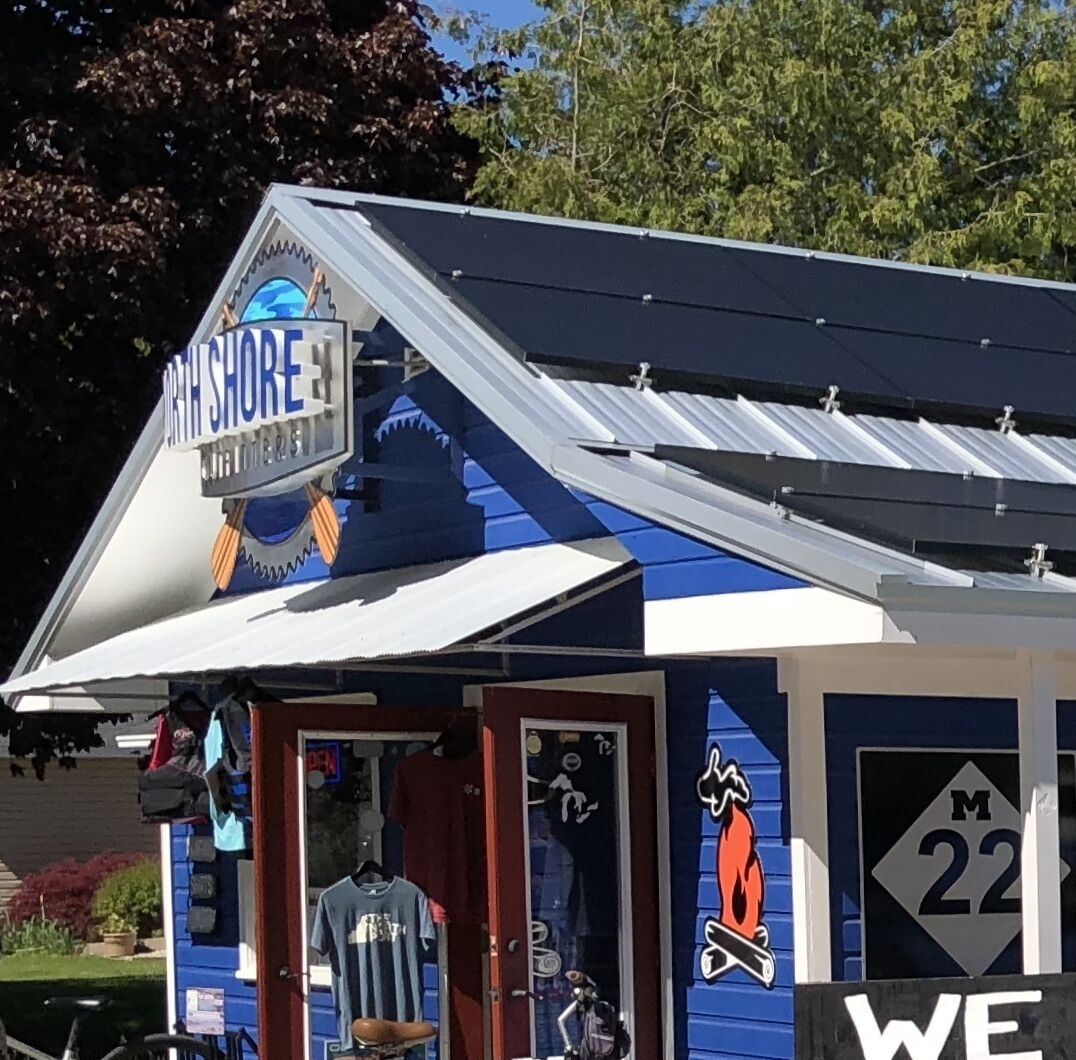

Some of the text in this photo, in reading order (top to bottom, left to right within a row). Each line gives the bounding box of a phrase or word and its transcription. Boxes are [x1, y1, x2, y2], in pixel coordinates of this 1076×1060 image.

[162, 329, 304, 448] ORTH SHORE
[951, 790, 992, 821] M
[918, 828, 1022, 916] 22
